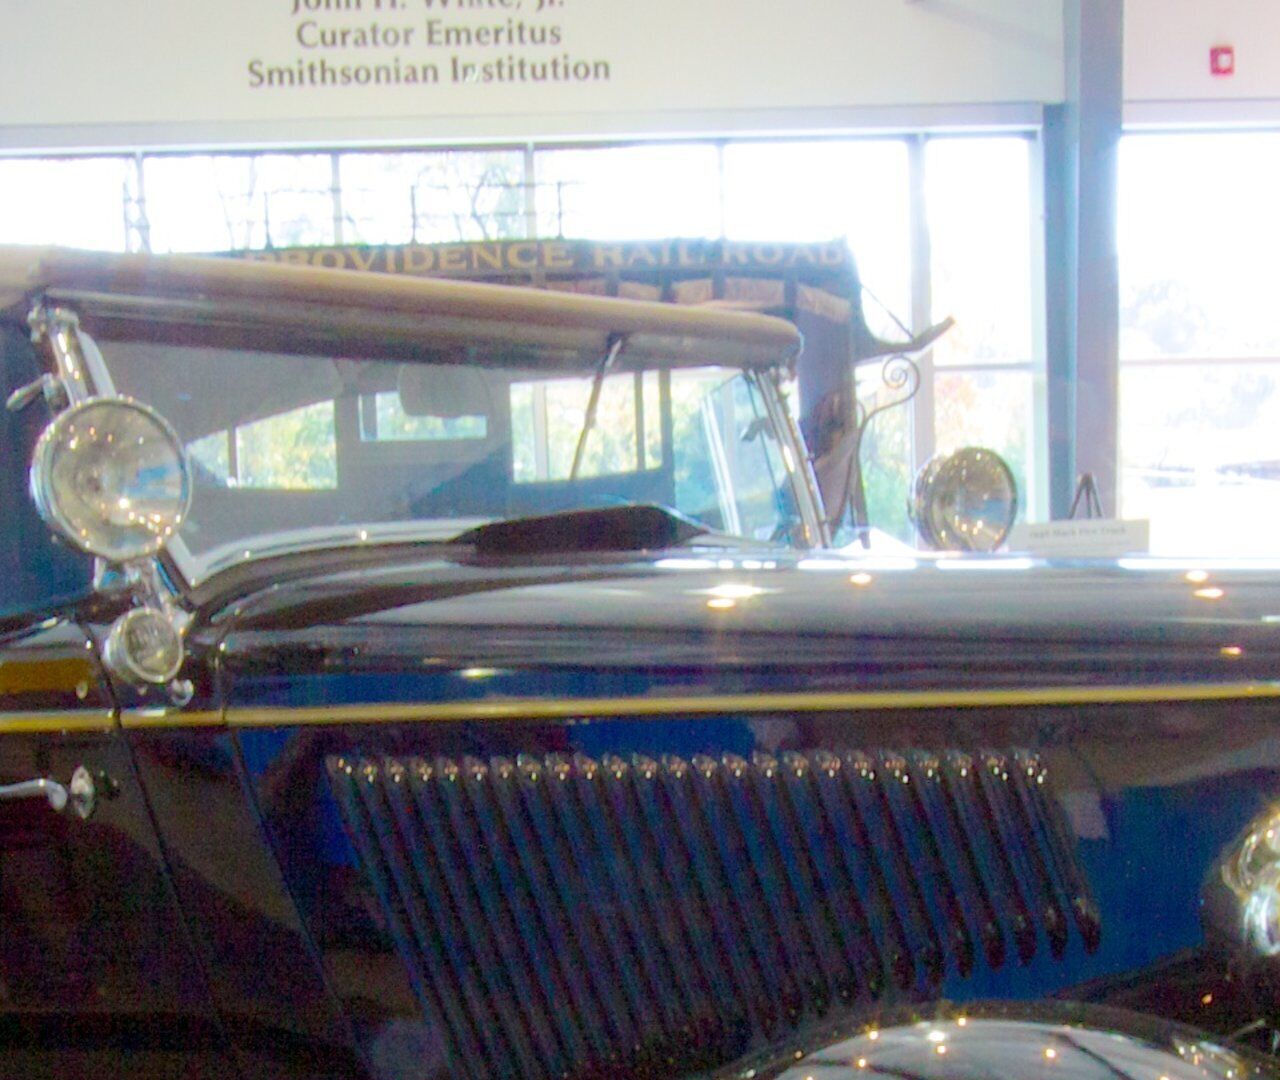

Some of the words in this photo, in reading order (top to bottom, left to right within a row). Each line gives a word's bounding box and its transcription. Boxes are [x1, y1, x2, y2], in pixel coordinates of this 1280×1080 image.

[295, 18, 415, 48] Curator
[425, 17, 563, 46] Emeritus
[247, 58, 440, 89] Smithsonian
[451, 54, 612, 84] Institution
